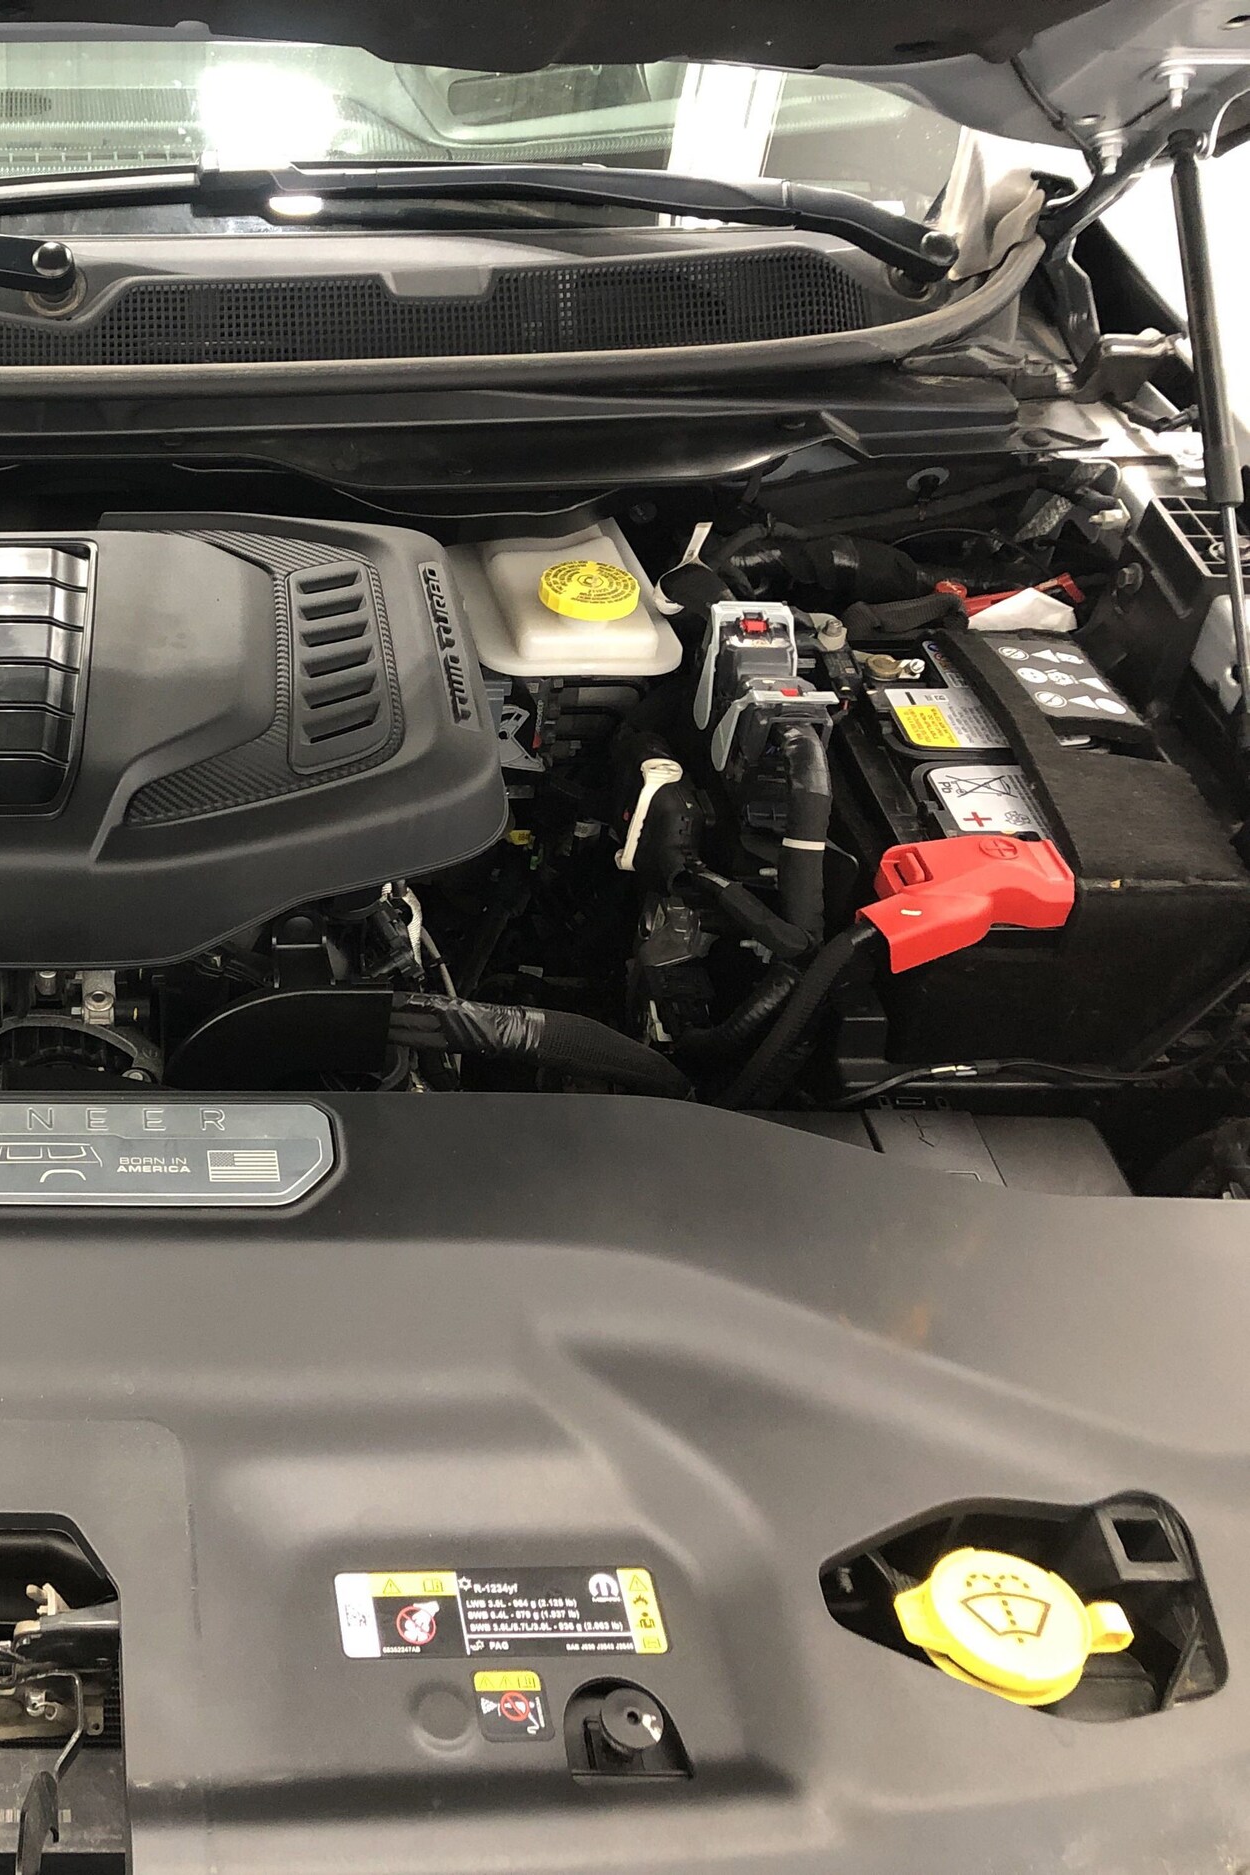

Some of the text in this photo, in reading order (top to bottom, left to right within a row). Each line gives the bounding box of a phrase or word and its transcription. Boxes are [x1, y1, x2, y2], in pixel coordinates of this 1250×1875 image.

[422, 565, 455, 651] TURBO
[119, 1157, 187, 1165] BORN IN
[116, 1165, 191, 1173] AMERICA
[489, 1641, 509, 1650] PAG
